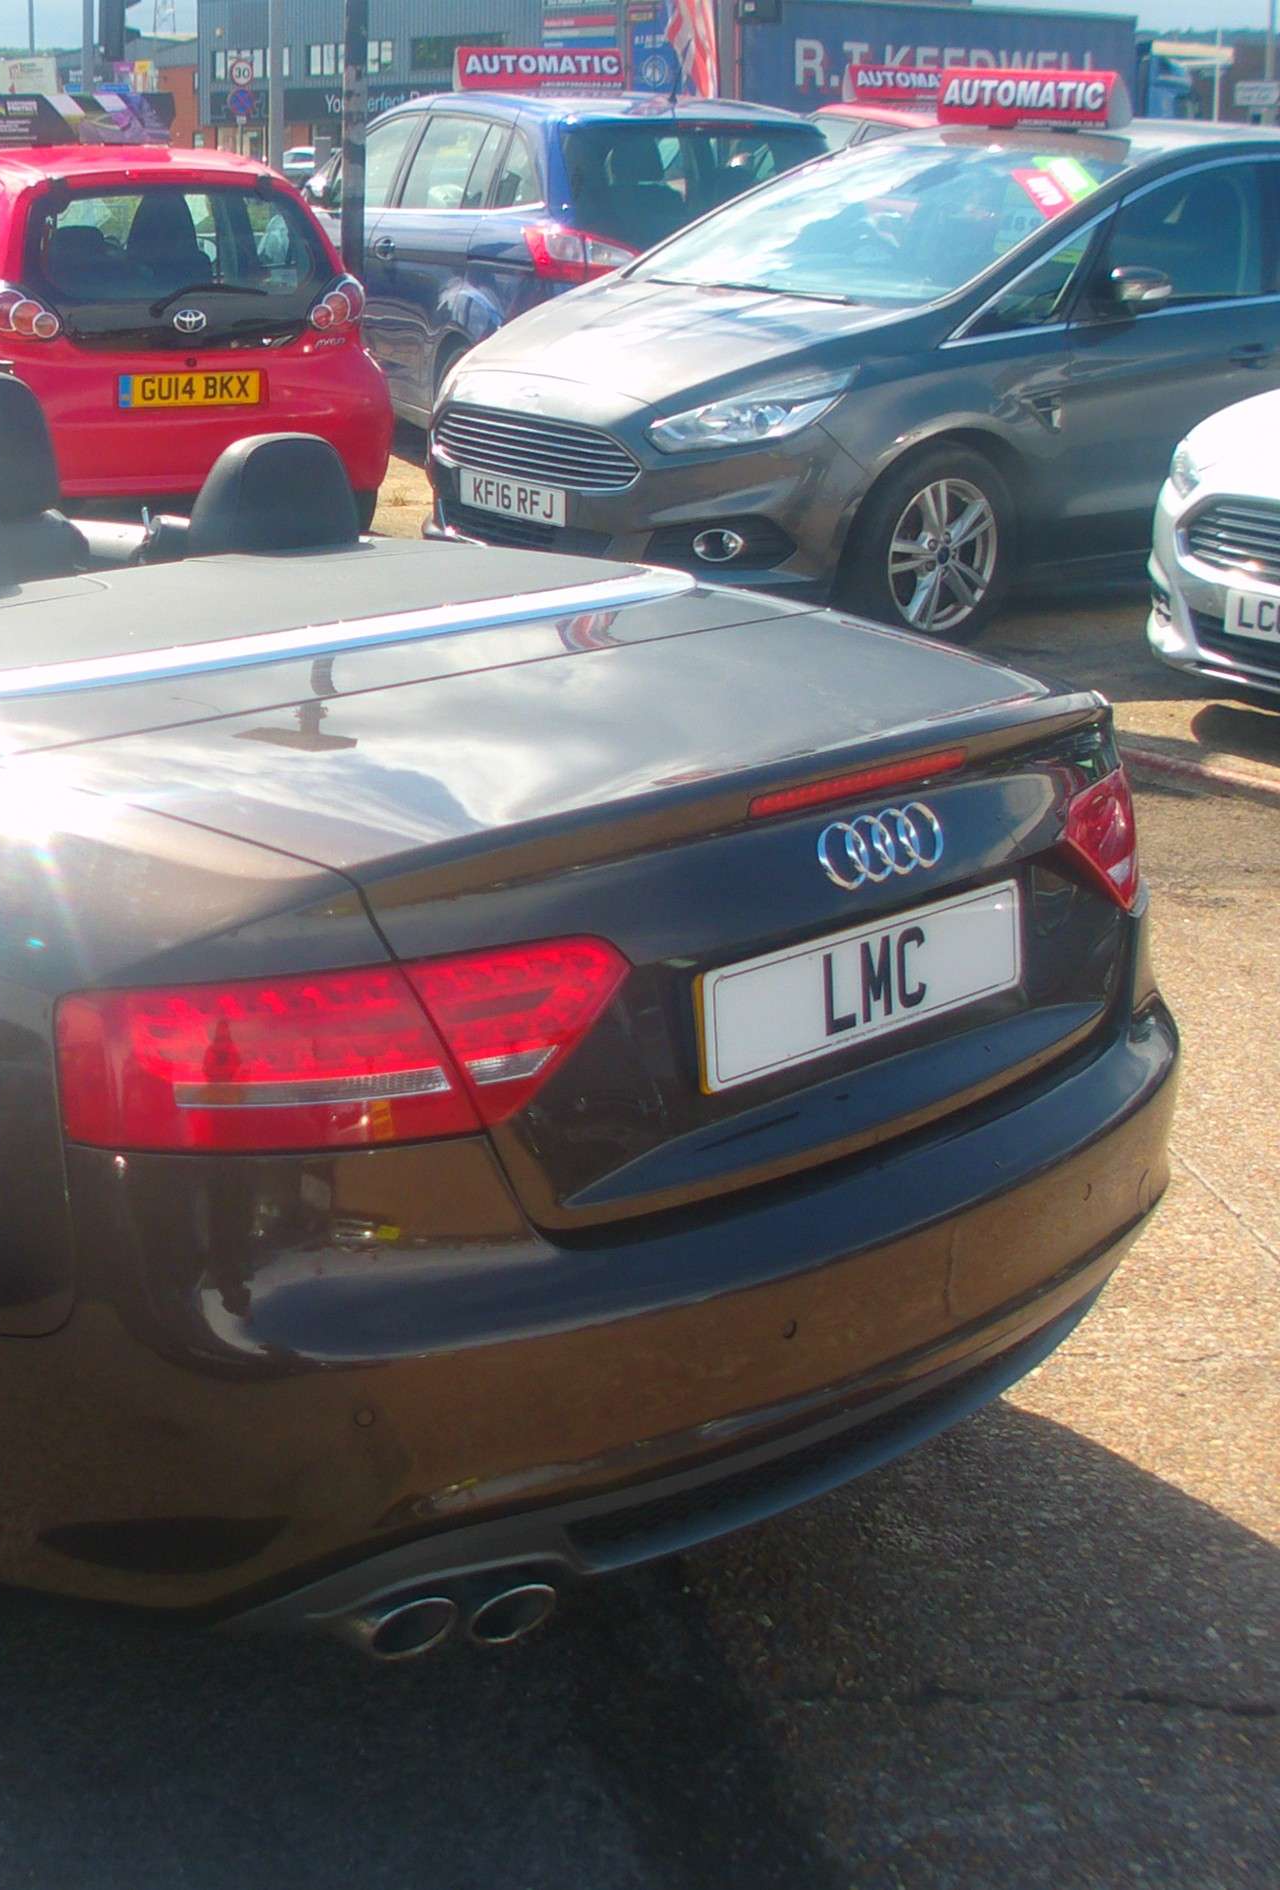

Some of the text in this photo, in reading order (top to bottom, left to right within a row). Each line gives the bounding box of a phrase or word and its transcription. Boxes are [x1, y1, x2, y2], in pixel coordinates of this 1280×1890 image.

[234, 65, 251, 79] 30
[465, 54, 620, 76] AUTOMATIC
[856, 70, 942, 88] AUTOMA
[943, 78, 1106, 110] AUTOMATIC
[140, 374, 251, 401] GU14 BKX
[473, 477, 554, 519] KF16 RFJ
[1237, 596, 1280, 634] LC
[822, 926, 927, 1036] LMC
